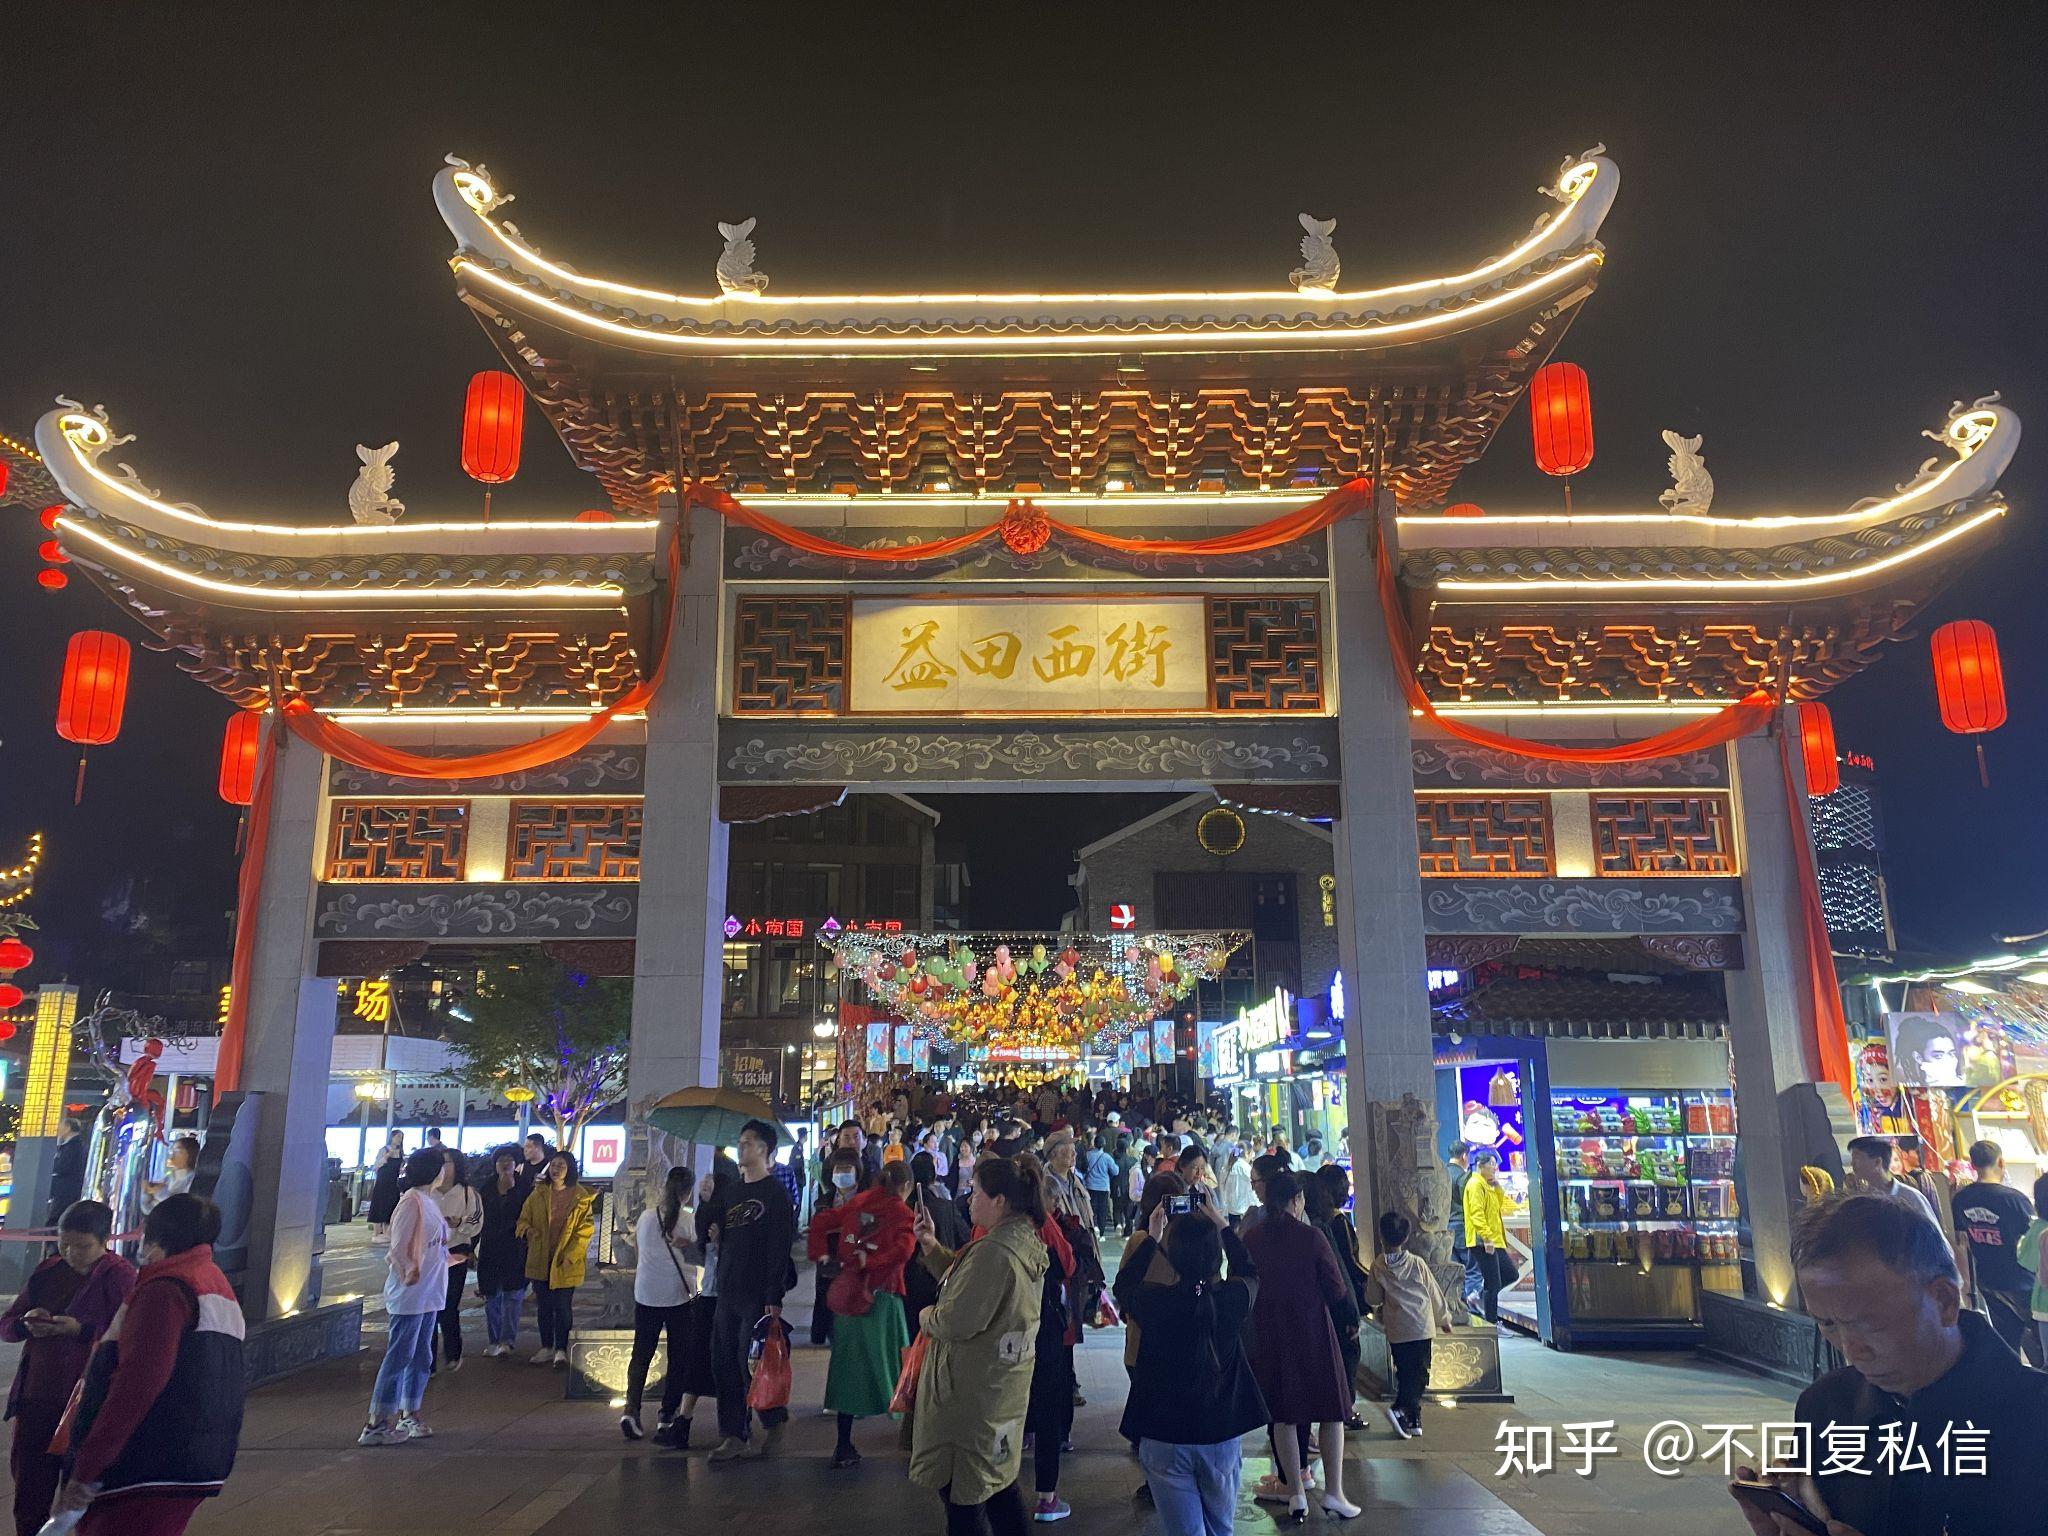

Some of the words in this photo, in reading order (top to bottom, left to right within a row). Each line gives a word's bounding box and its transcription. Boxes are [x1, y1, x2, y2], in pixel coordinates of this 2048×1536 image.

[882, 620, 1172, 691] 益田西街
[744, 918, 804, 937] 小南国
